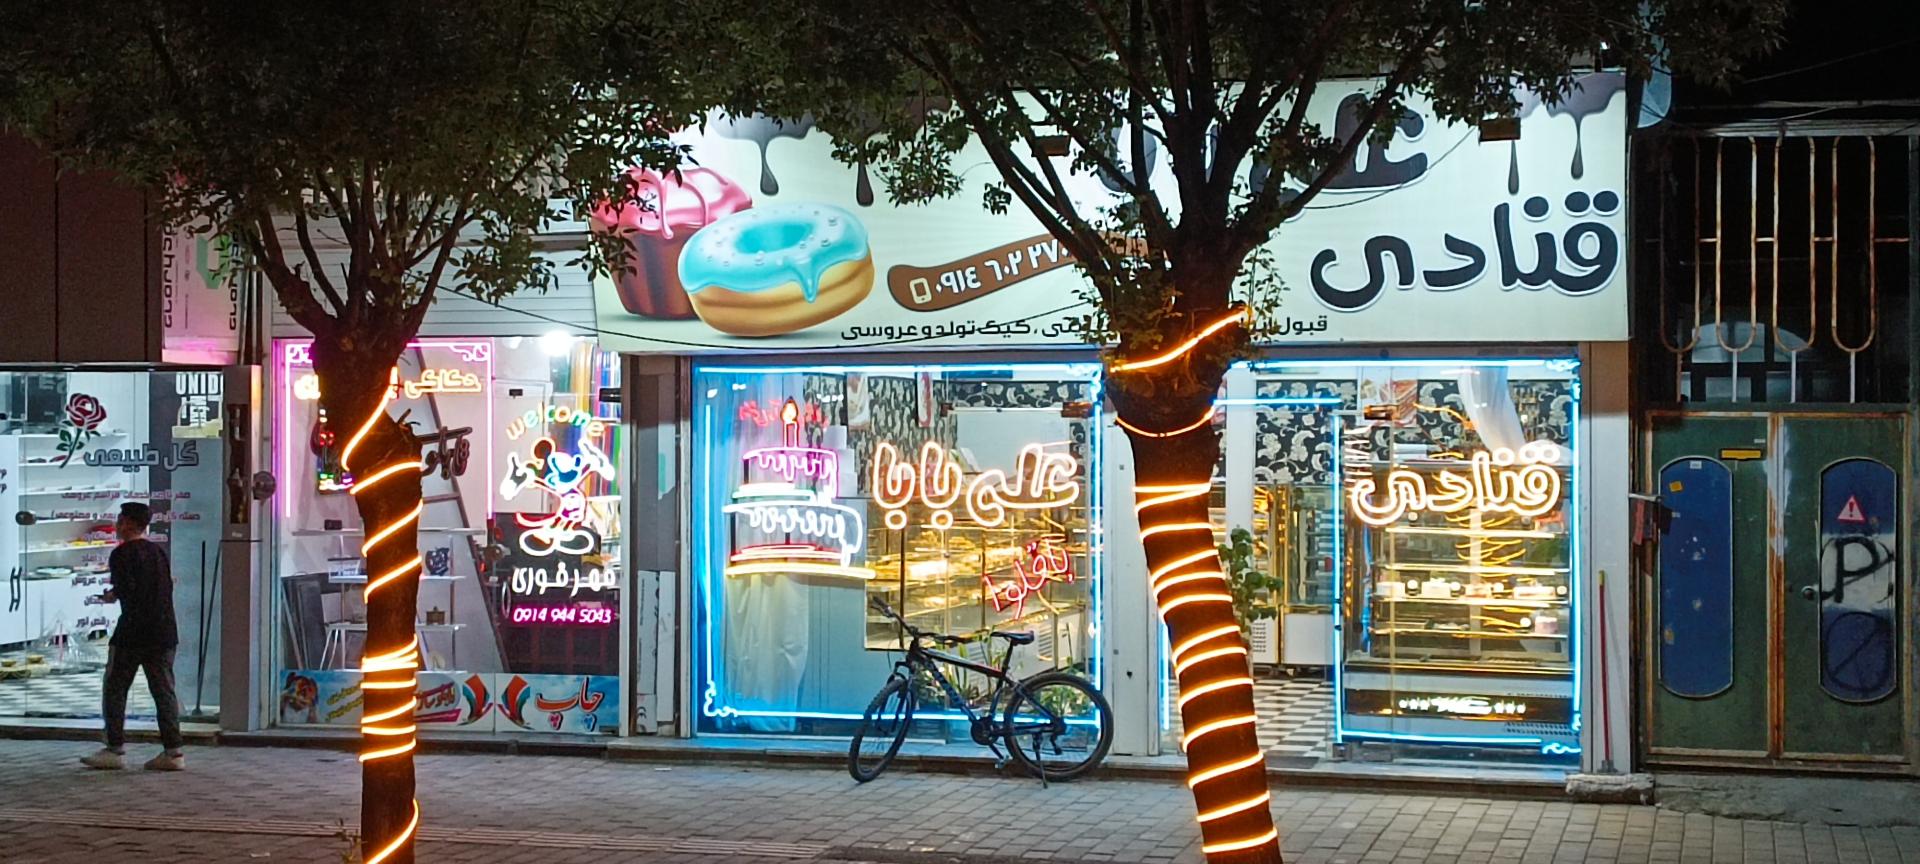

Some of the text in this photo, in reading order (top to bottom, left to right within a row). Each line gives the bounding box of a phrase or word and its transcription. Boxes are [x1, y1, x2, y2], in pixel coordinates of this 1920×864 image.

[1311, 190, 1619, 309] قنادی
[841, 322, 919, 341] عروسی
[936, 320, 976, 339] تولد
[976, 320, 1031, 339] کیک
[1279, 314, 1328, 336] قبول
[175, 372, 223, 395] UNID
[83, 440, 200, 473] گل طبیعی
[872, 441, 1080, 530] علی بابا
[1351, 439, 1561, 525] قنادی
[512, 561, 616, 598] مهر فوری
[513, 607, 612, 623] 0914 944 5043
[535, 677, 605, 731] چاپ
